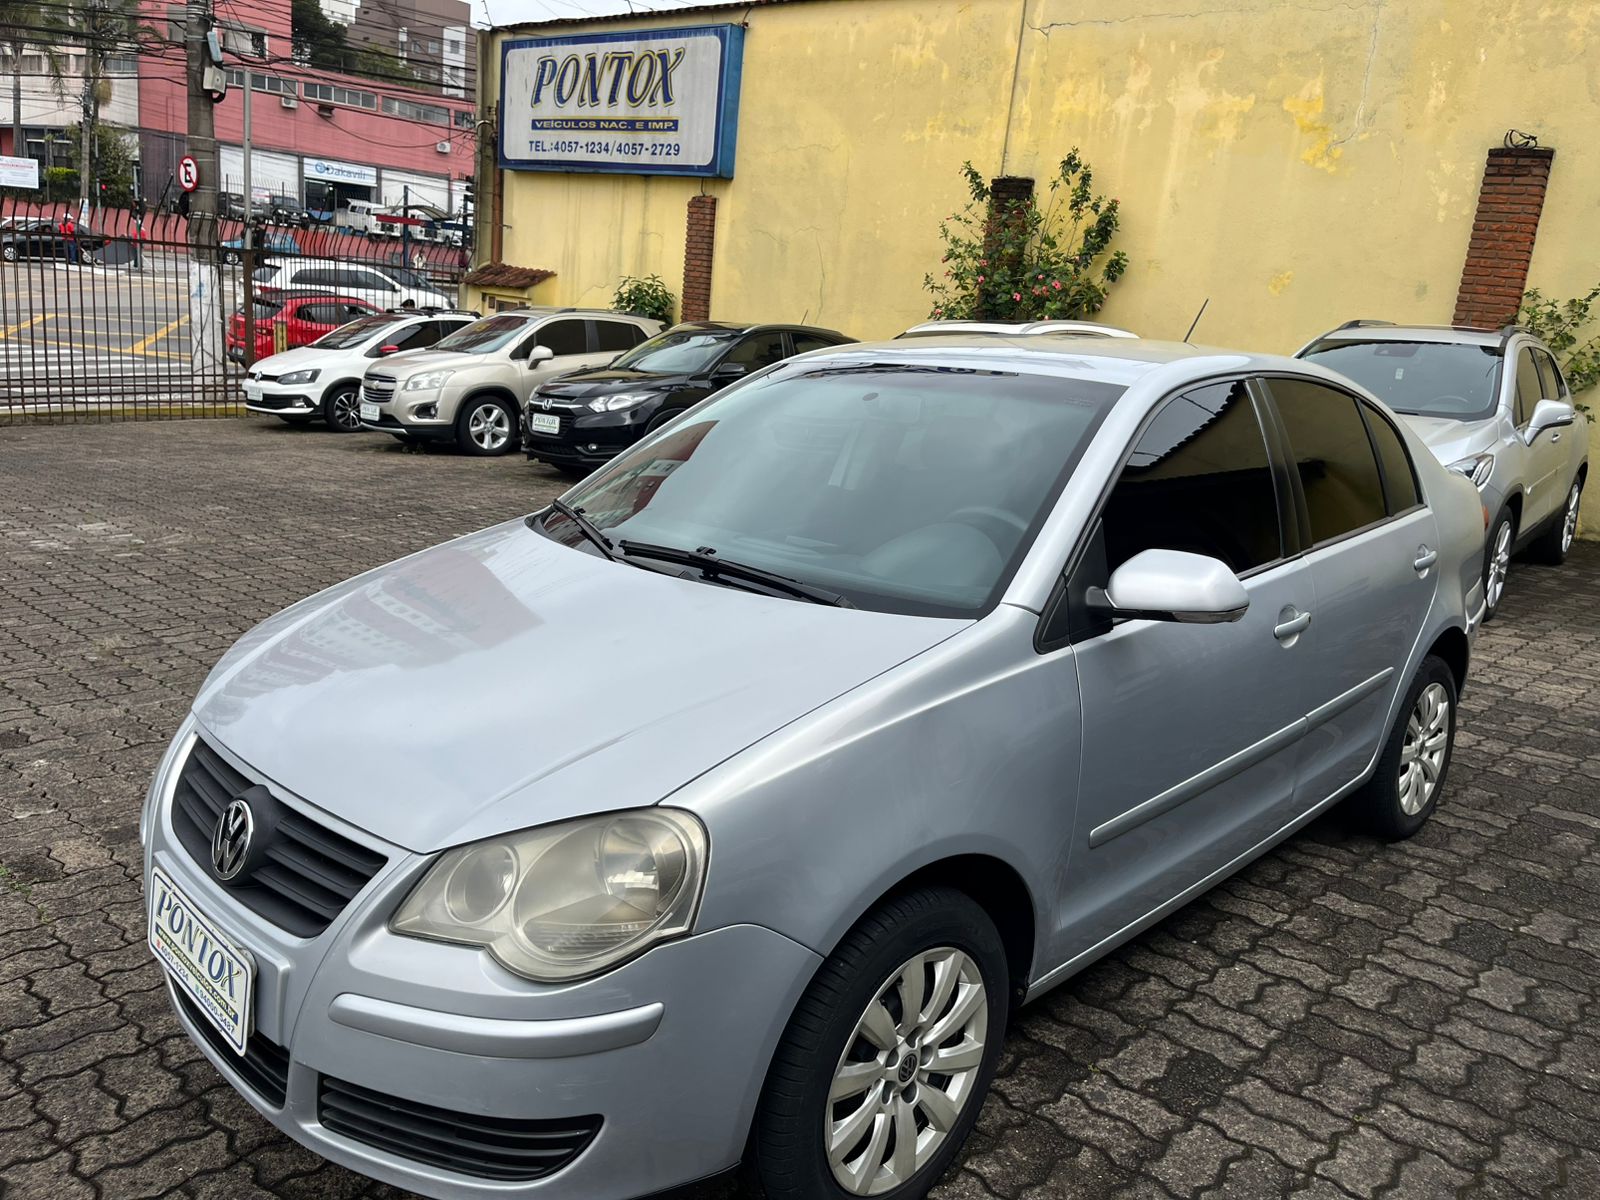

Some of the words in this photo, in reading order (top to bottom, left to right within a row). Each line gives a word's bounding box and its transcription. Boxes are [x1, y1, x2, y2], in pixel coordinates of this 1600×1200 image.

[530, 47, 686, 108] PONTOX
[600, 121, 632, 129] NAC.
[635, 121, 645, 129] E
[648, 121, 675, 130] IMP.
[155, 886, 242, 1004] PONTOX
